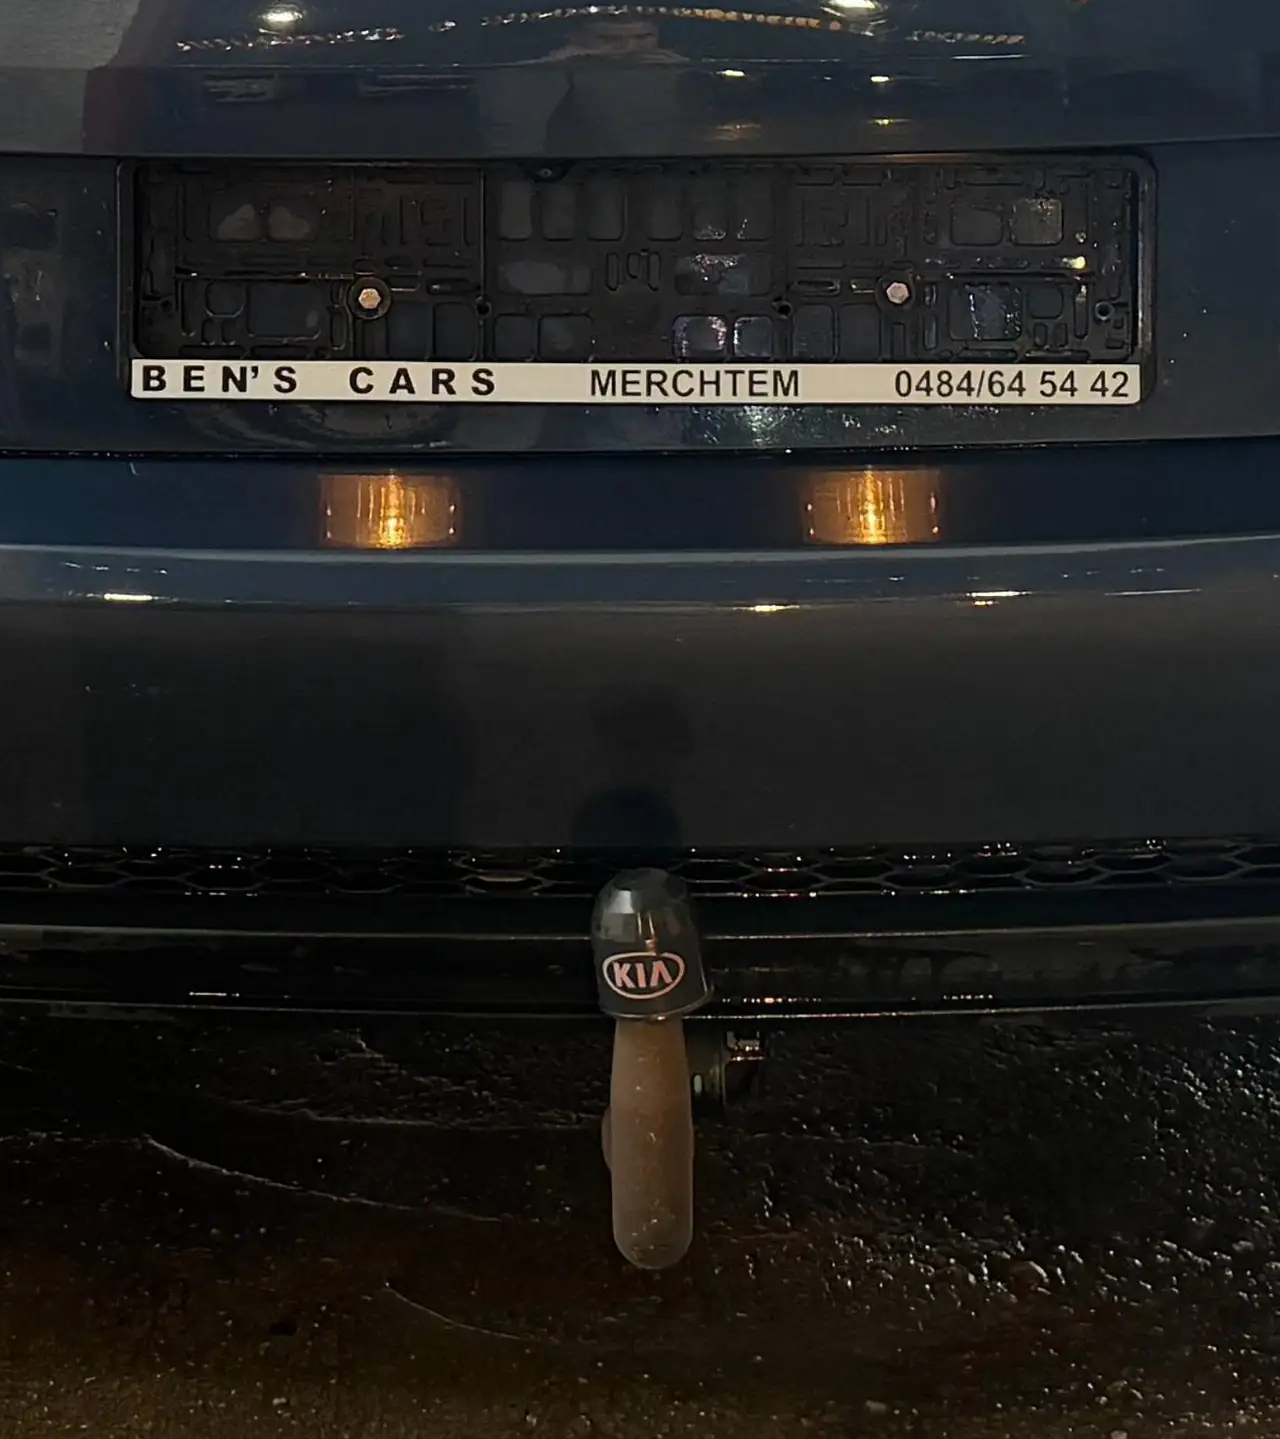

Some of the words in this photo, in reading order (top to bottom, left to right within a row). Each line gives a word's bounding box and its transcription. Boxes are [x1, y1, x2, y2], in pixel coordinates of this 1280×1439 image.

[141, 364, 298, 394] BEN'S
[348, 366, 496, 396] CARS
[590, 368, 801, 398] MERCHTEM
[894, 369, 1027, 399] 0484/64
[1038, 369, 1079, 399] 54
[1090, 369, 1131, 399] 42
[612, 960, 673, 989] KIA
